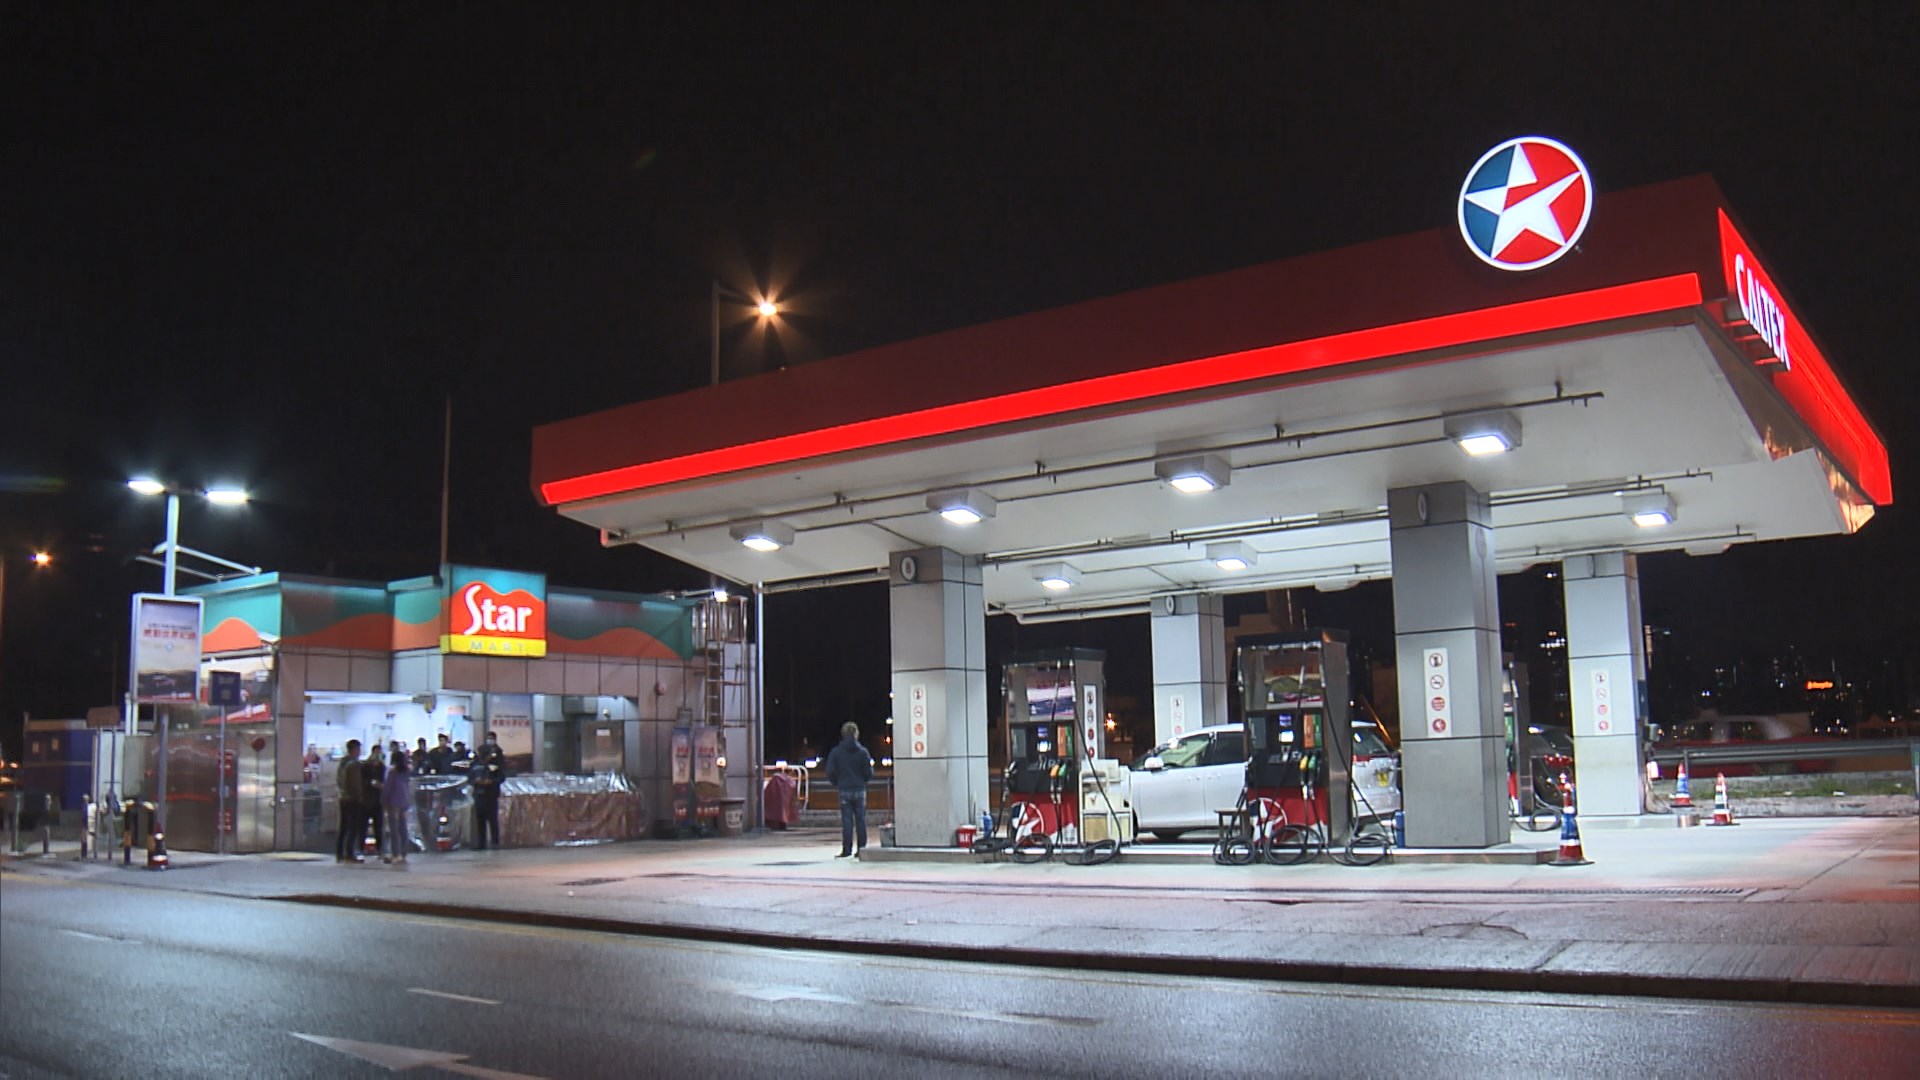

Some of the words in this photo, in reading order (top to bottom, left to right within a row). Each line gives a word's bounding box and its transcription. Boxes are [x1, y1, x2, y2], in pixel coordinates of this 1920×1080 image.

[1735, 253, 1790, 371] CALTEX
[463, 585, 533, 635] Star
[470, 641, 524, 653] MART
